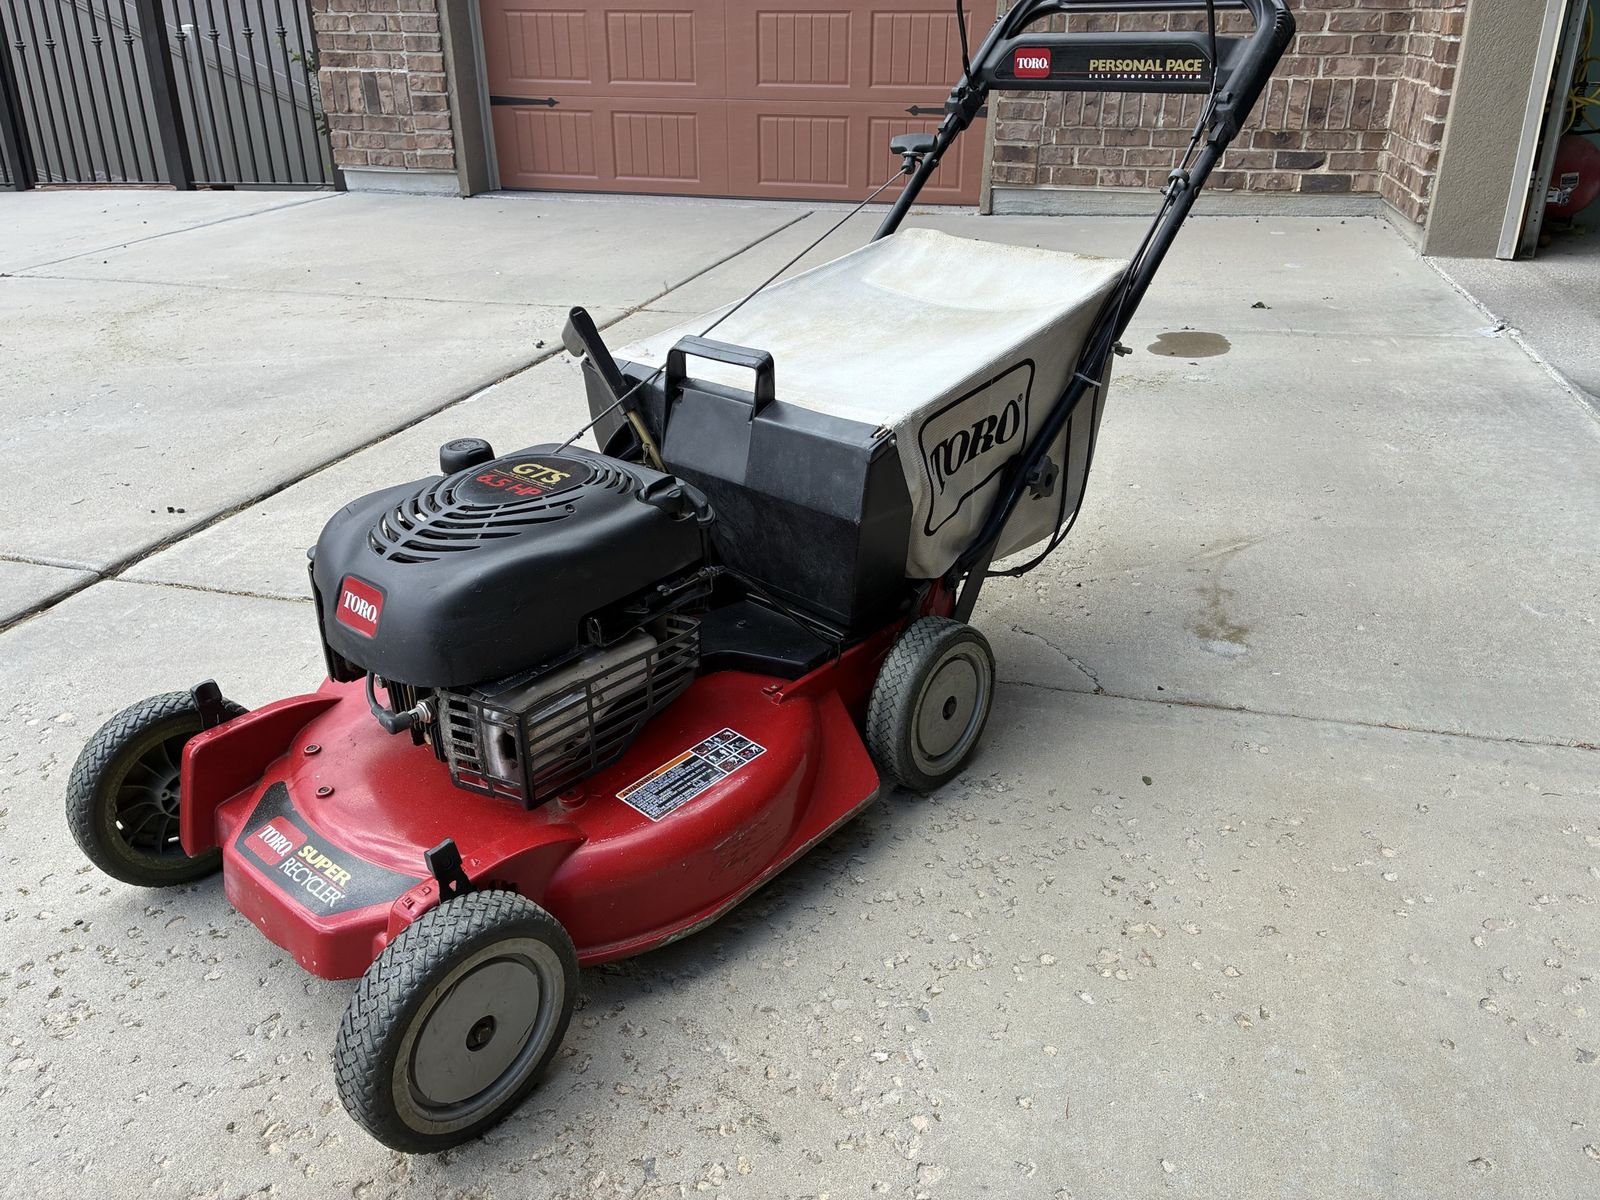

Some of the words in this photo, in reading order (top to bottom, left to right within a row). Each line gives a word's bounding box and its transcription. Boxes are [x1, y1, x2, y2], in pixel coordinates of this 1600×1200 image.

[1016, 57, 1048, 70] TORO
[1089, 59, 1163, 72] PERSONAL
[1165, 58, 1203, 72] PACE
[476, 473, 513, 487] 6.5
[505, 483, 542, 496] HP
[512, 463, 571, 484] GTS
[343, 590, 378, 623] TORO
[257, 824, 294, 857] TORO
[297, 845, 352, 887] SUPER
[278, 857, 342, 907] RECYCLER
